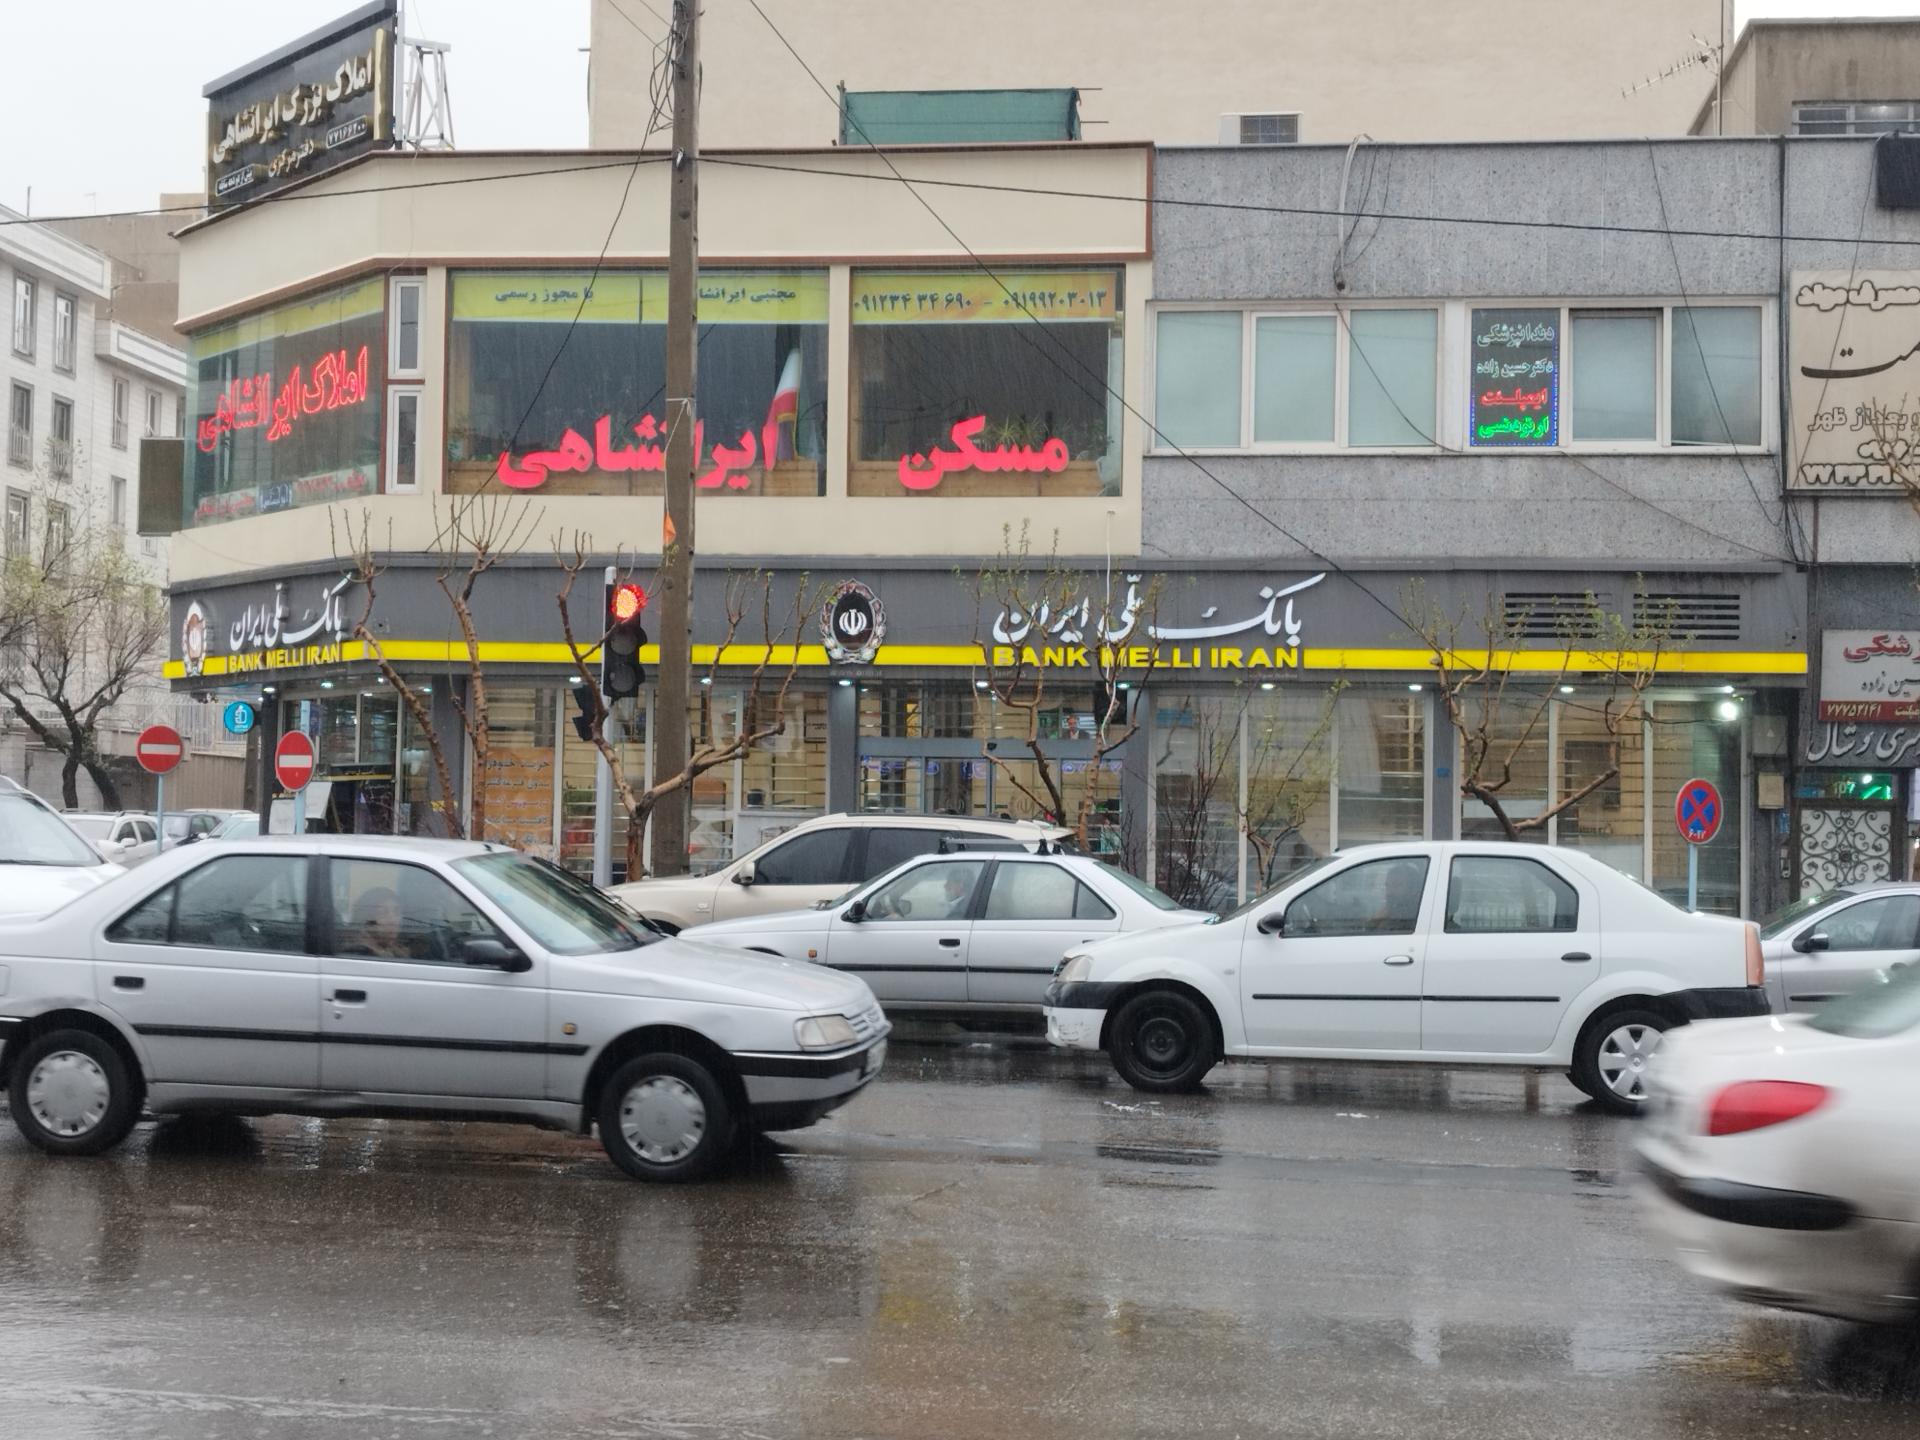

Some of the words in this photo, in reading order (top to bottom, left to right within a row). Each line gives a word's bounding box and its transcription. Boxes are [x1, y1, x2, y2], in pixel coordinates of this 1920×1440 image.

[326, 47, 373, 102] املاک
[212, 95, 279, 164] ایرانشاهی
[495, 291, 537, 302] رسمی
[541, 288, 578, 303] مجوز
[302, 345, 368, 415] املاک
[197, 365, 301, 452] ایرانشاهی
[1807, 407, 1848, 432] ظهر
[497, 413, 778, 490] ایراشاهی
[898, 414, 1070, 490] مسکن
[230, 603, 265, 651] ایران
[282, 572, 352, 643] بانک
[993, 596, 1089, 644] ایران
[1147, 572, 1326, 647] بانک
[228, 651, 266, 674] BANK
[266, 647, 304, 670] MELLI
[306, 641, 340, 666] IRAN
[993, 646, 1090, 668] BANK
[1101, 646, 1201, 668] MELLI
[1210, 647, 1298, 669] IRAN
